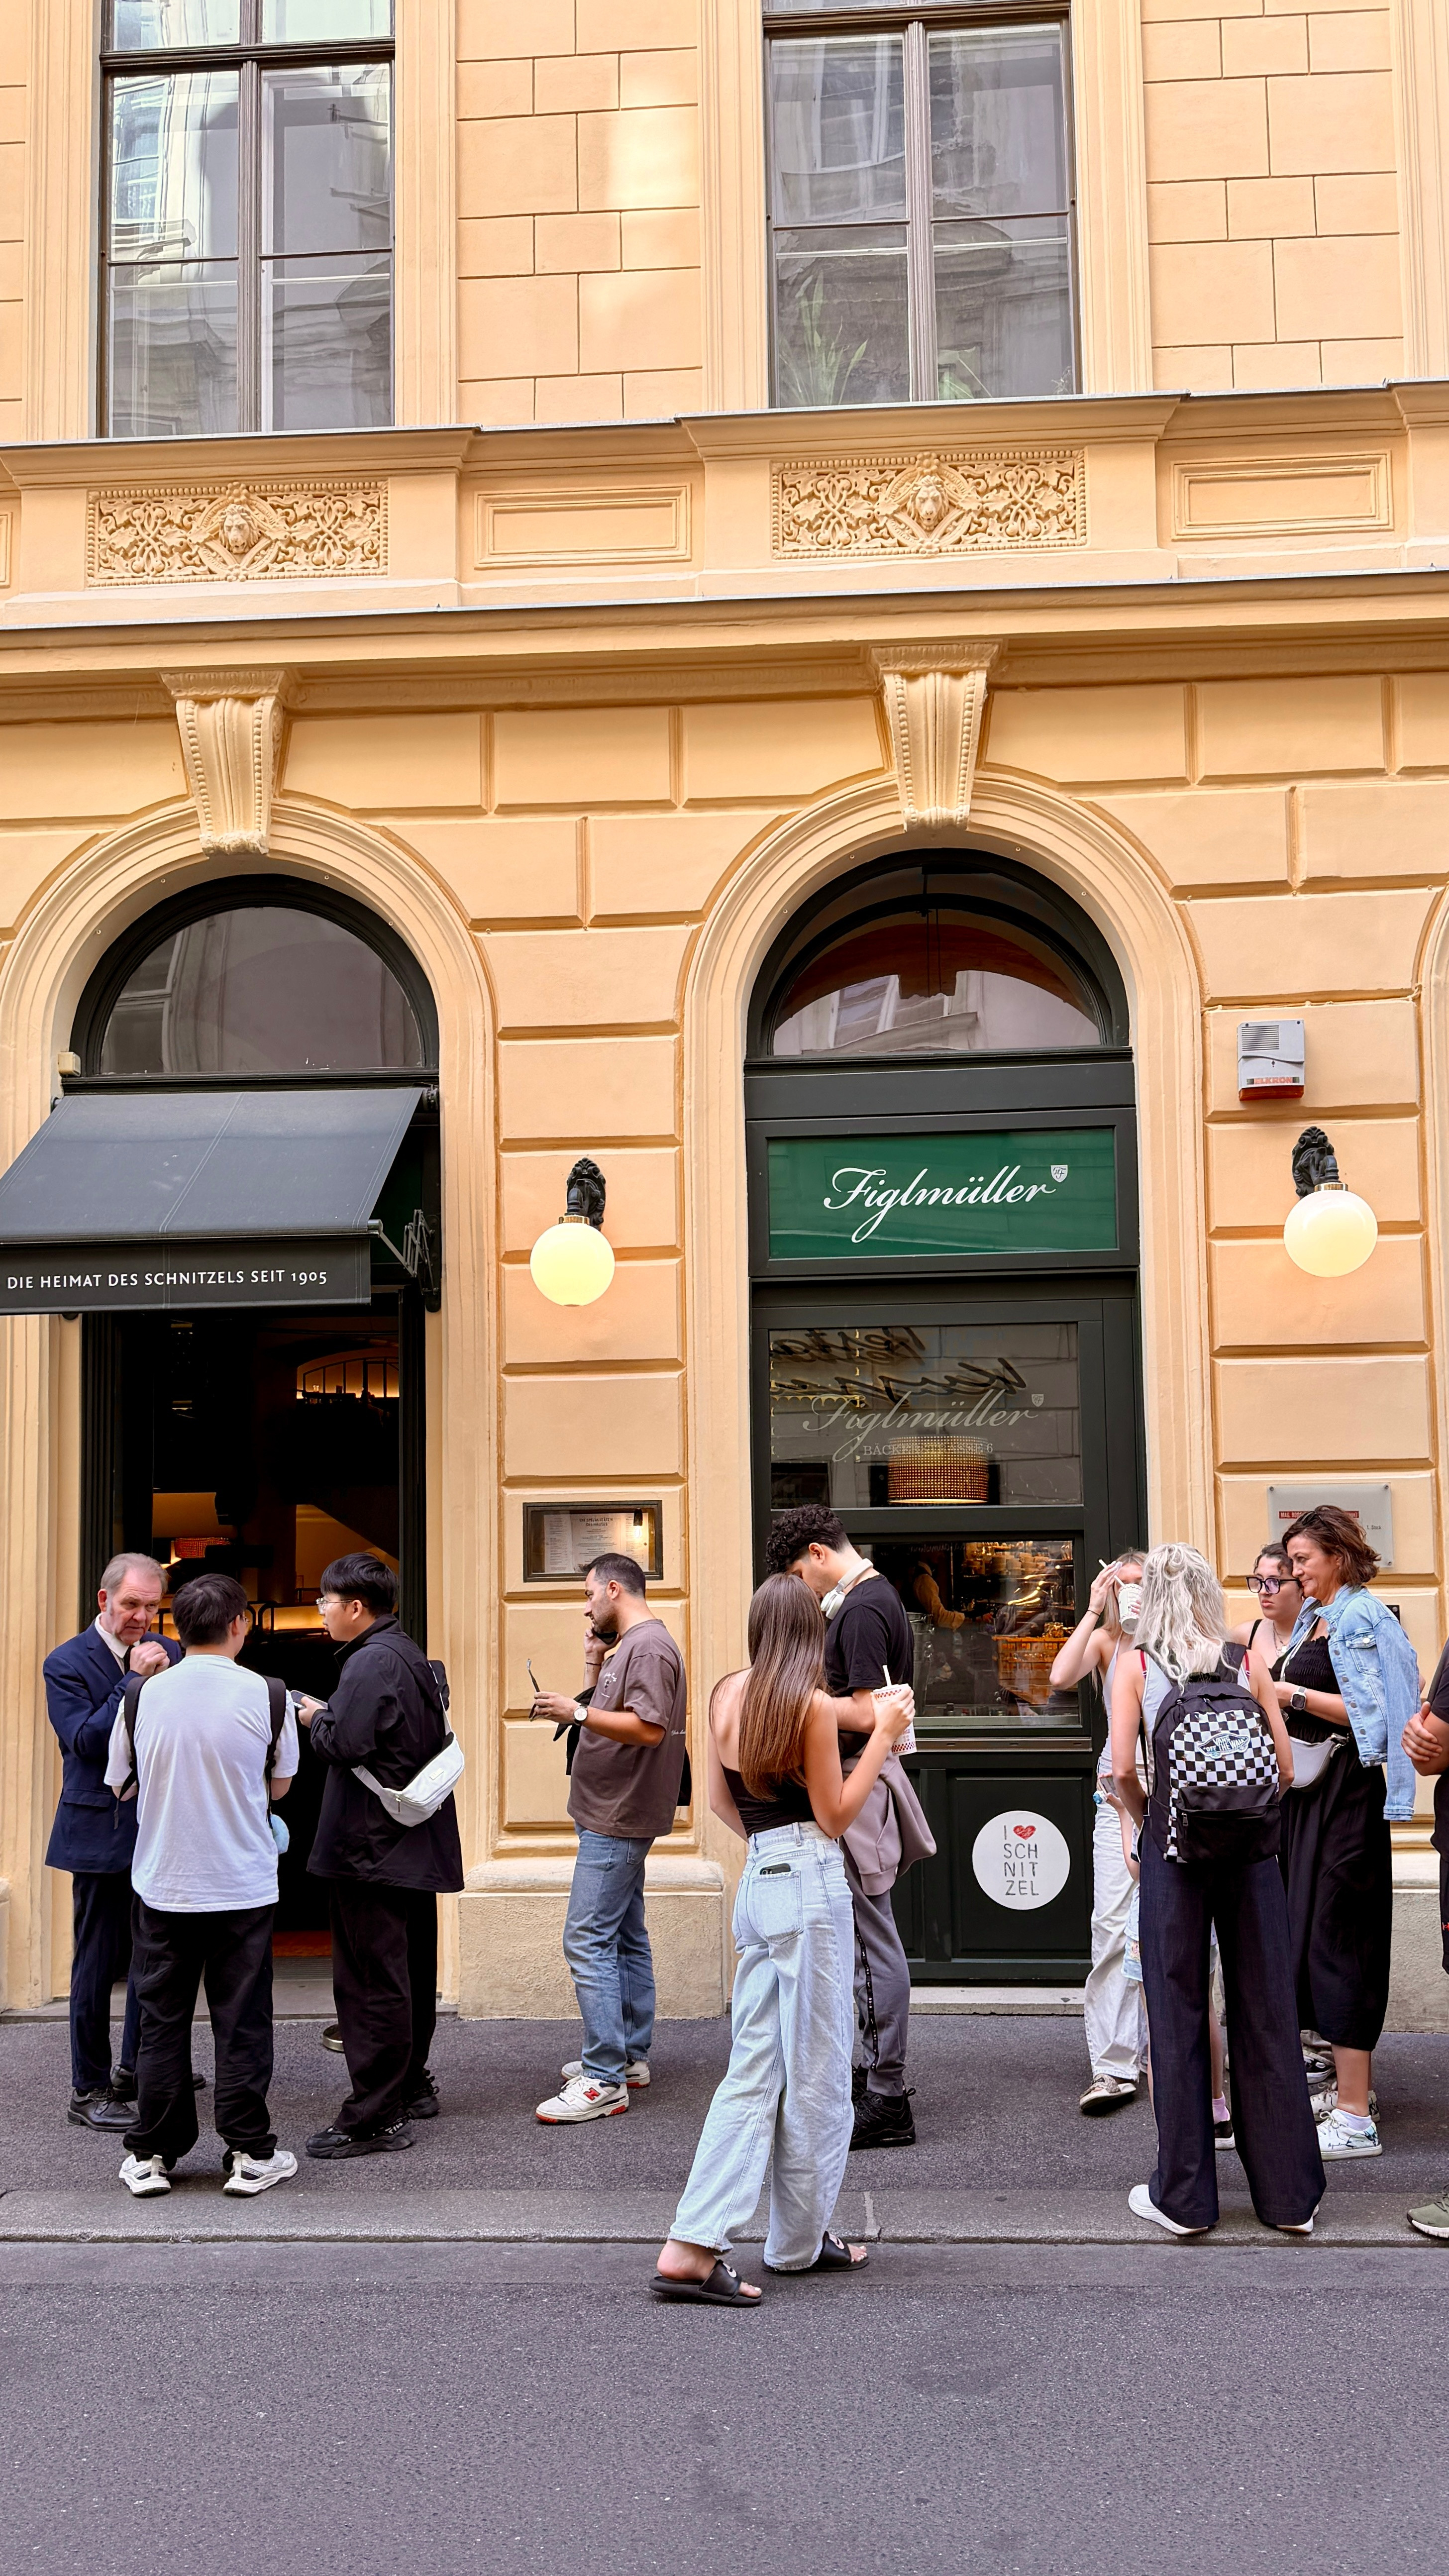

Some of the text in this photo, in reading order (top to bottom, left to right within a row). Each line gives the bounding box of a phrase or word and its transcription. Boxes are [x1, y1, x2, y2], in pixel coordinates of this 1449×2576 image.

[824, 1165, 1056, 1243] Figlmüller
[7, 1270, 326, 1289] DIE HEIMAT DES SCHNITZELS SEIT 1905
[803, 1389, 1038, 1462] Figlmüller
[987, 1443, 993, 1453] 6
[1213, 1735, 1231, 1747] VANS
[1218, 1742, 1231, 1751] THE
[1004, 1825, 1007, 1840] I
[1003, 1843, 1038, 1859] SCH
[1004, 1861, 1038, 1877] NIT
[1005, 1880, 1039, 1896] ZEL
